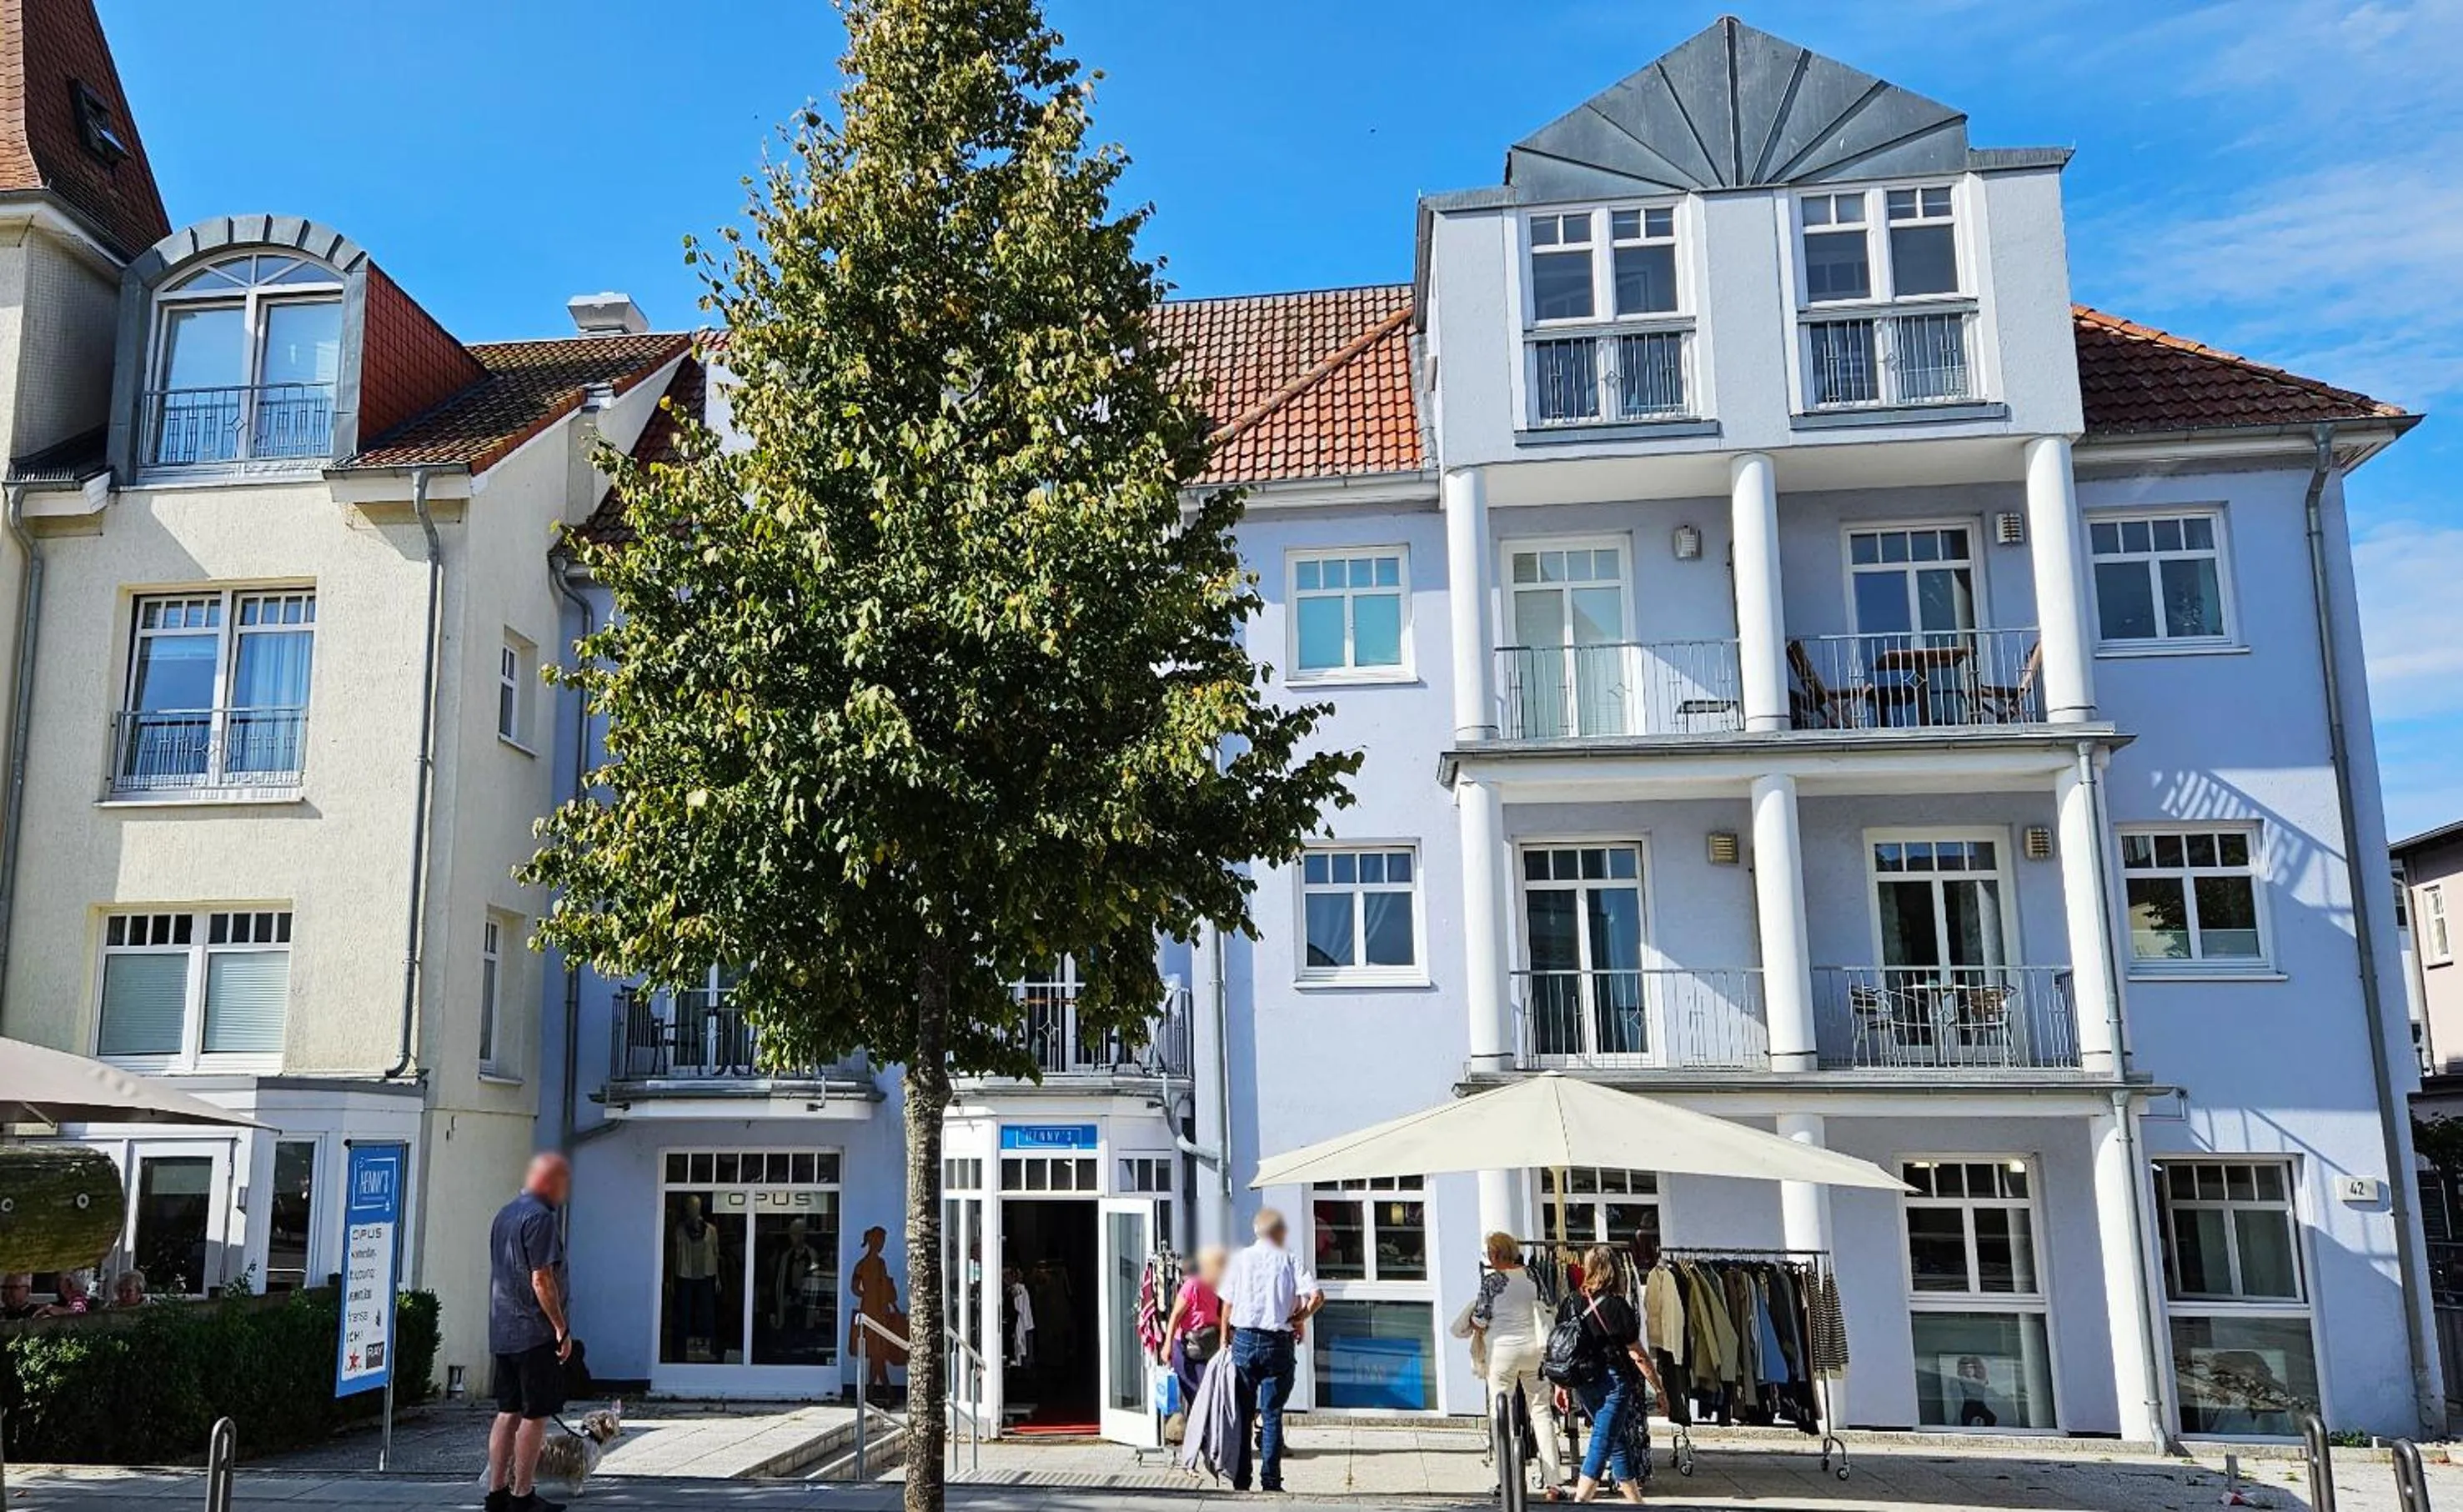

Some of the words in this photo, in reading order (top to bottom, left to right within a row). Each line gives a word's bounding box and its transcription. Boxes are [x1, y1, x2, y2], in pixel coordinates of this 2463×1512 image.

[2350, 1181, 2365, 1195] 42
[728, 1193, 812, 1206] OPUS
[353, 1227, 382, 1241] OPUS
